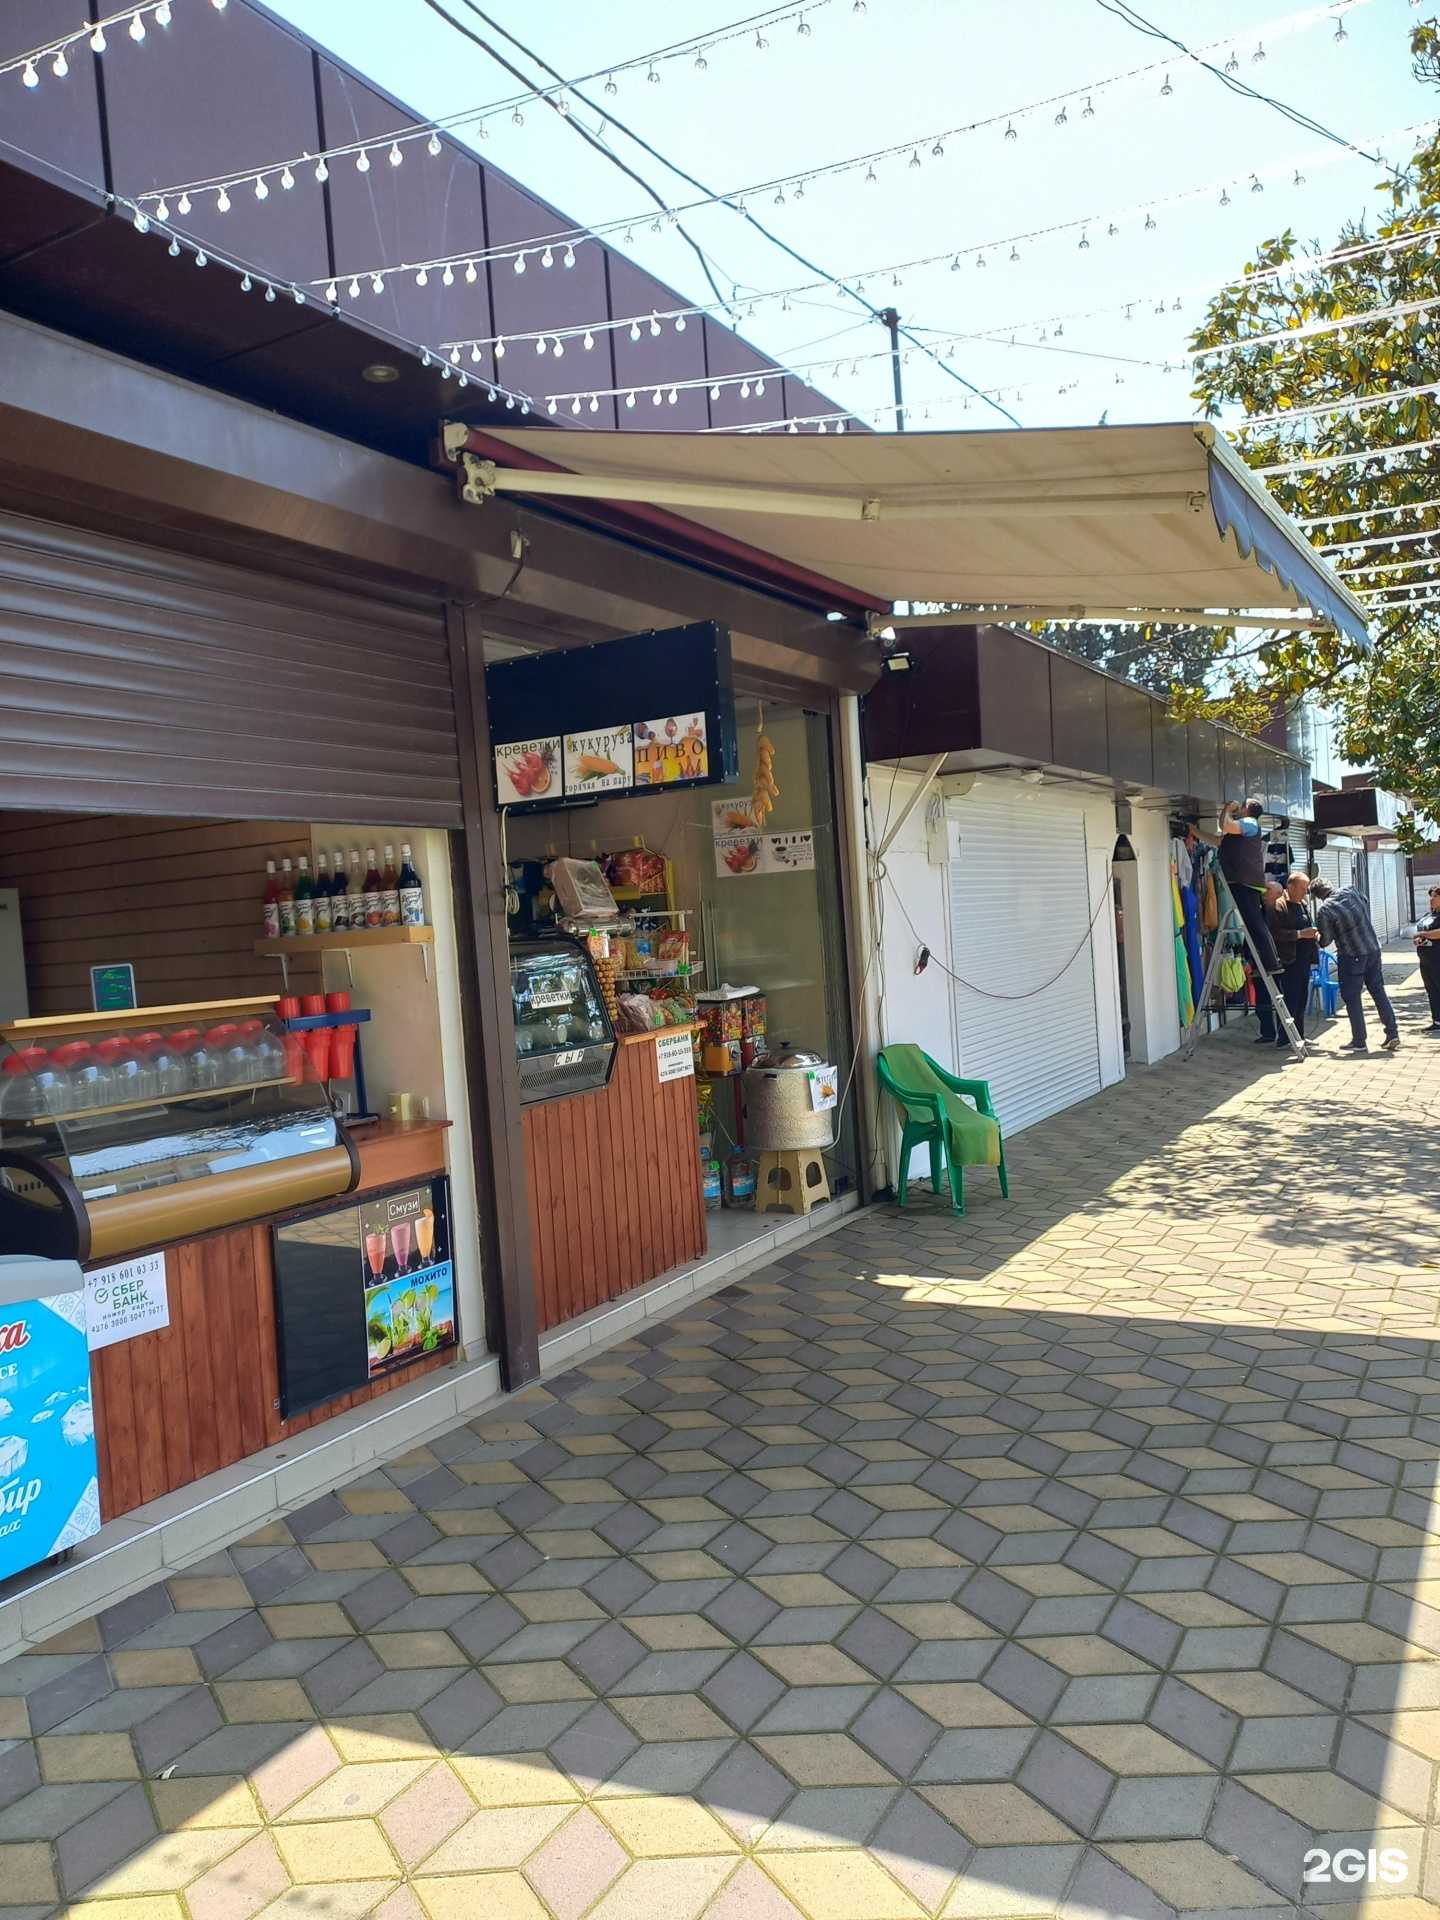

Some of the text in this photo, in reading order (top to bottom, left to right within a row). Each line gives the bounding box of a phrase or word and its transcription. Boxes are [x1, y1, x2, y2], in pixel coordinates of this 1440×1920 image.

[496, 739, 560, 758] креветки
[572, 731, 632, 756] кукуруза
[636, 740, 704, 763] ПИВО
[530, 992, 570, 1006] креветки
[389, 1200, 418, 1216] Смузи
[411, 1268, 447, 1287] МОХИТО
[112, 1280, 144, 1297] СБЕР
[113, 1290, 149, 1310] БАНК
